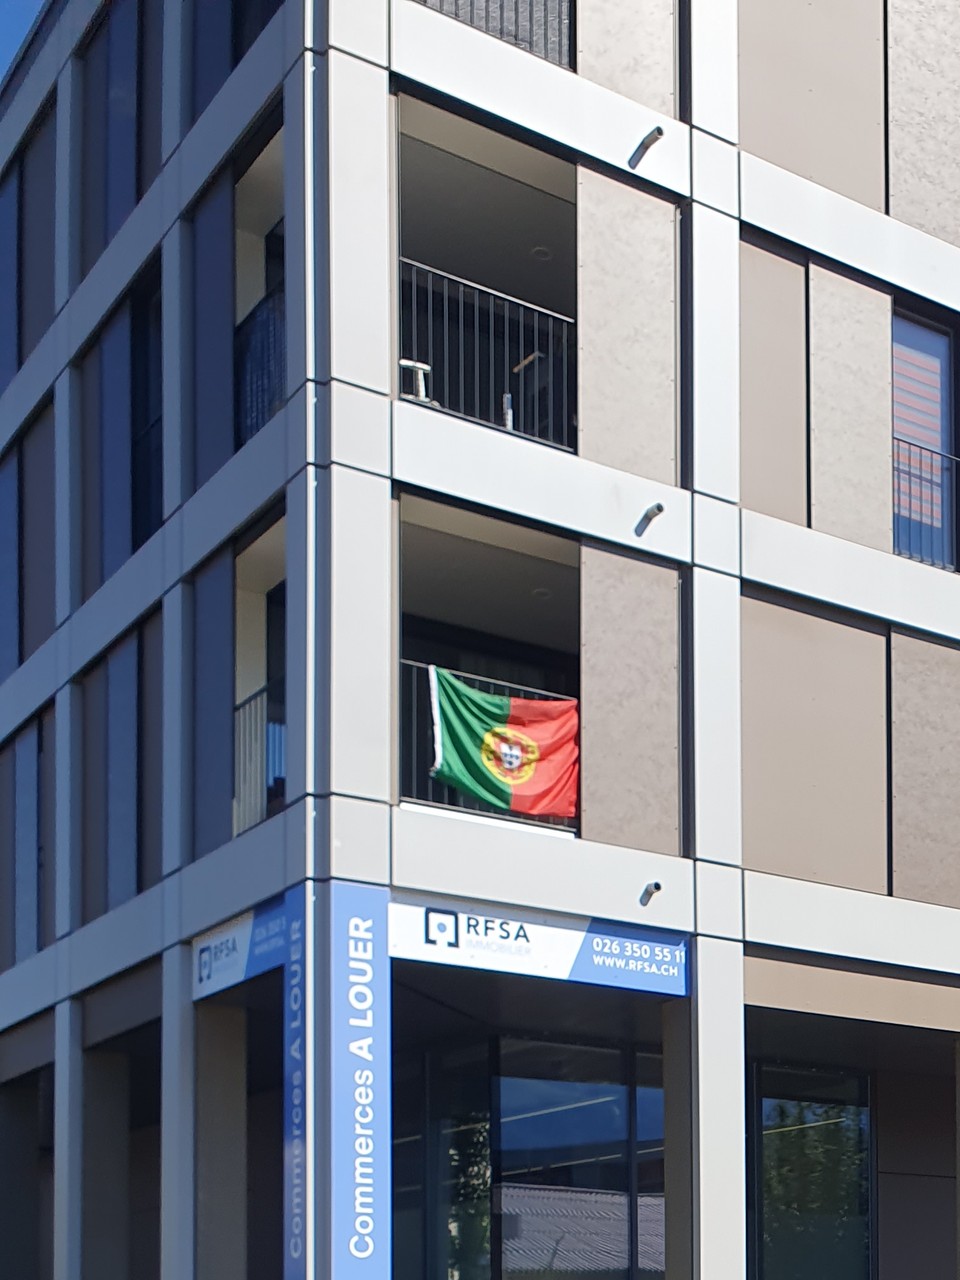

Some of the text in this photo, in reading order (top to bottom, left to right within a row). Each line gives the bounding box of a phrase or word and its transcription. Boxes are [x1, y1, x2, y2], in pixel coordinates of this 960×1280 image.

[465, 915, 531, 943] RFSA
[213, 936, 239, 961] RFSA
[592, 937, 621, 955] 026
[623, 942, 651, 959] 350
[654, 946, 672, 962] 55
[592, 954, 679, 977] WWW.RFSA.CH
[290, 1037, 302, 1062] A
[348, 916, 374, 1259] Commerces A LOUER
